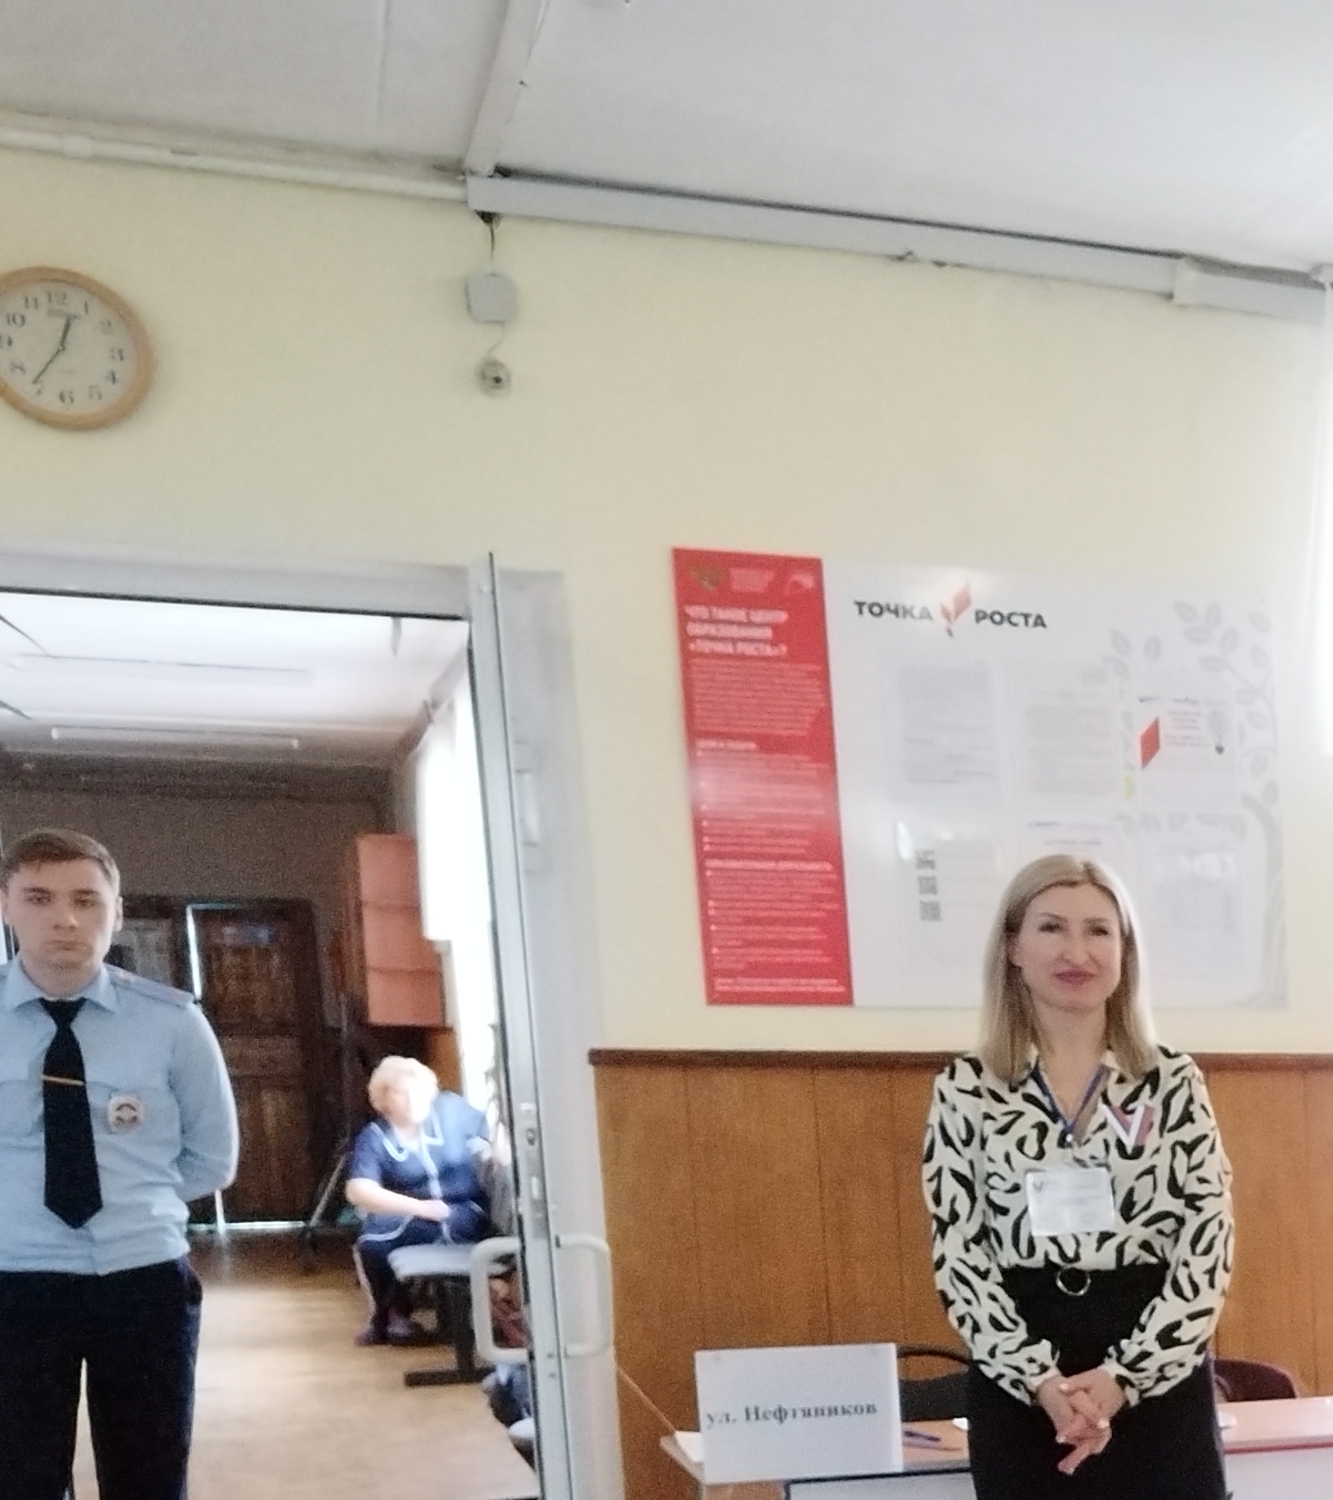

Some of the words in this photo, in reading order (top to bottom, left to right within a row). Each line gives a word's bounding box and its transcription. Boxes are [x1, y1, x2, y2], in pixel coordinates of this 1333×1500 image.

[6, 312, 27, 327] 10
[853, 599, 934, 622] ТОЧКА
[974, 608, 1048, 629] РОСТА
[706, 1411, 738, 1429] ул.
[743, 1402, 878, 1426] Нефтяников
